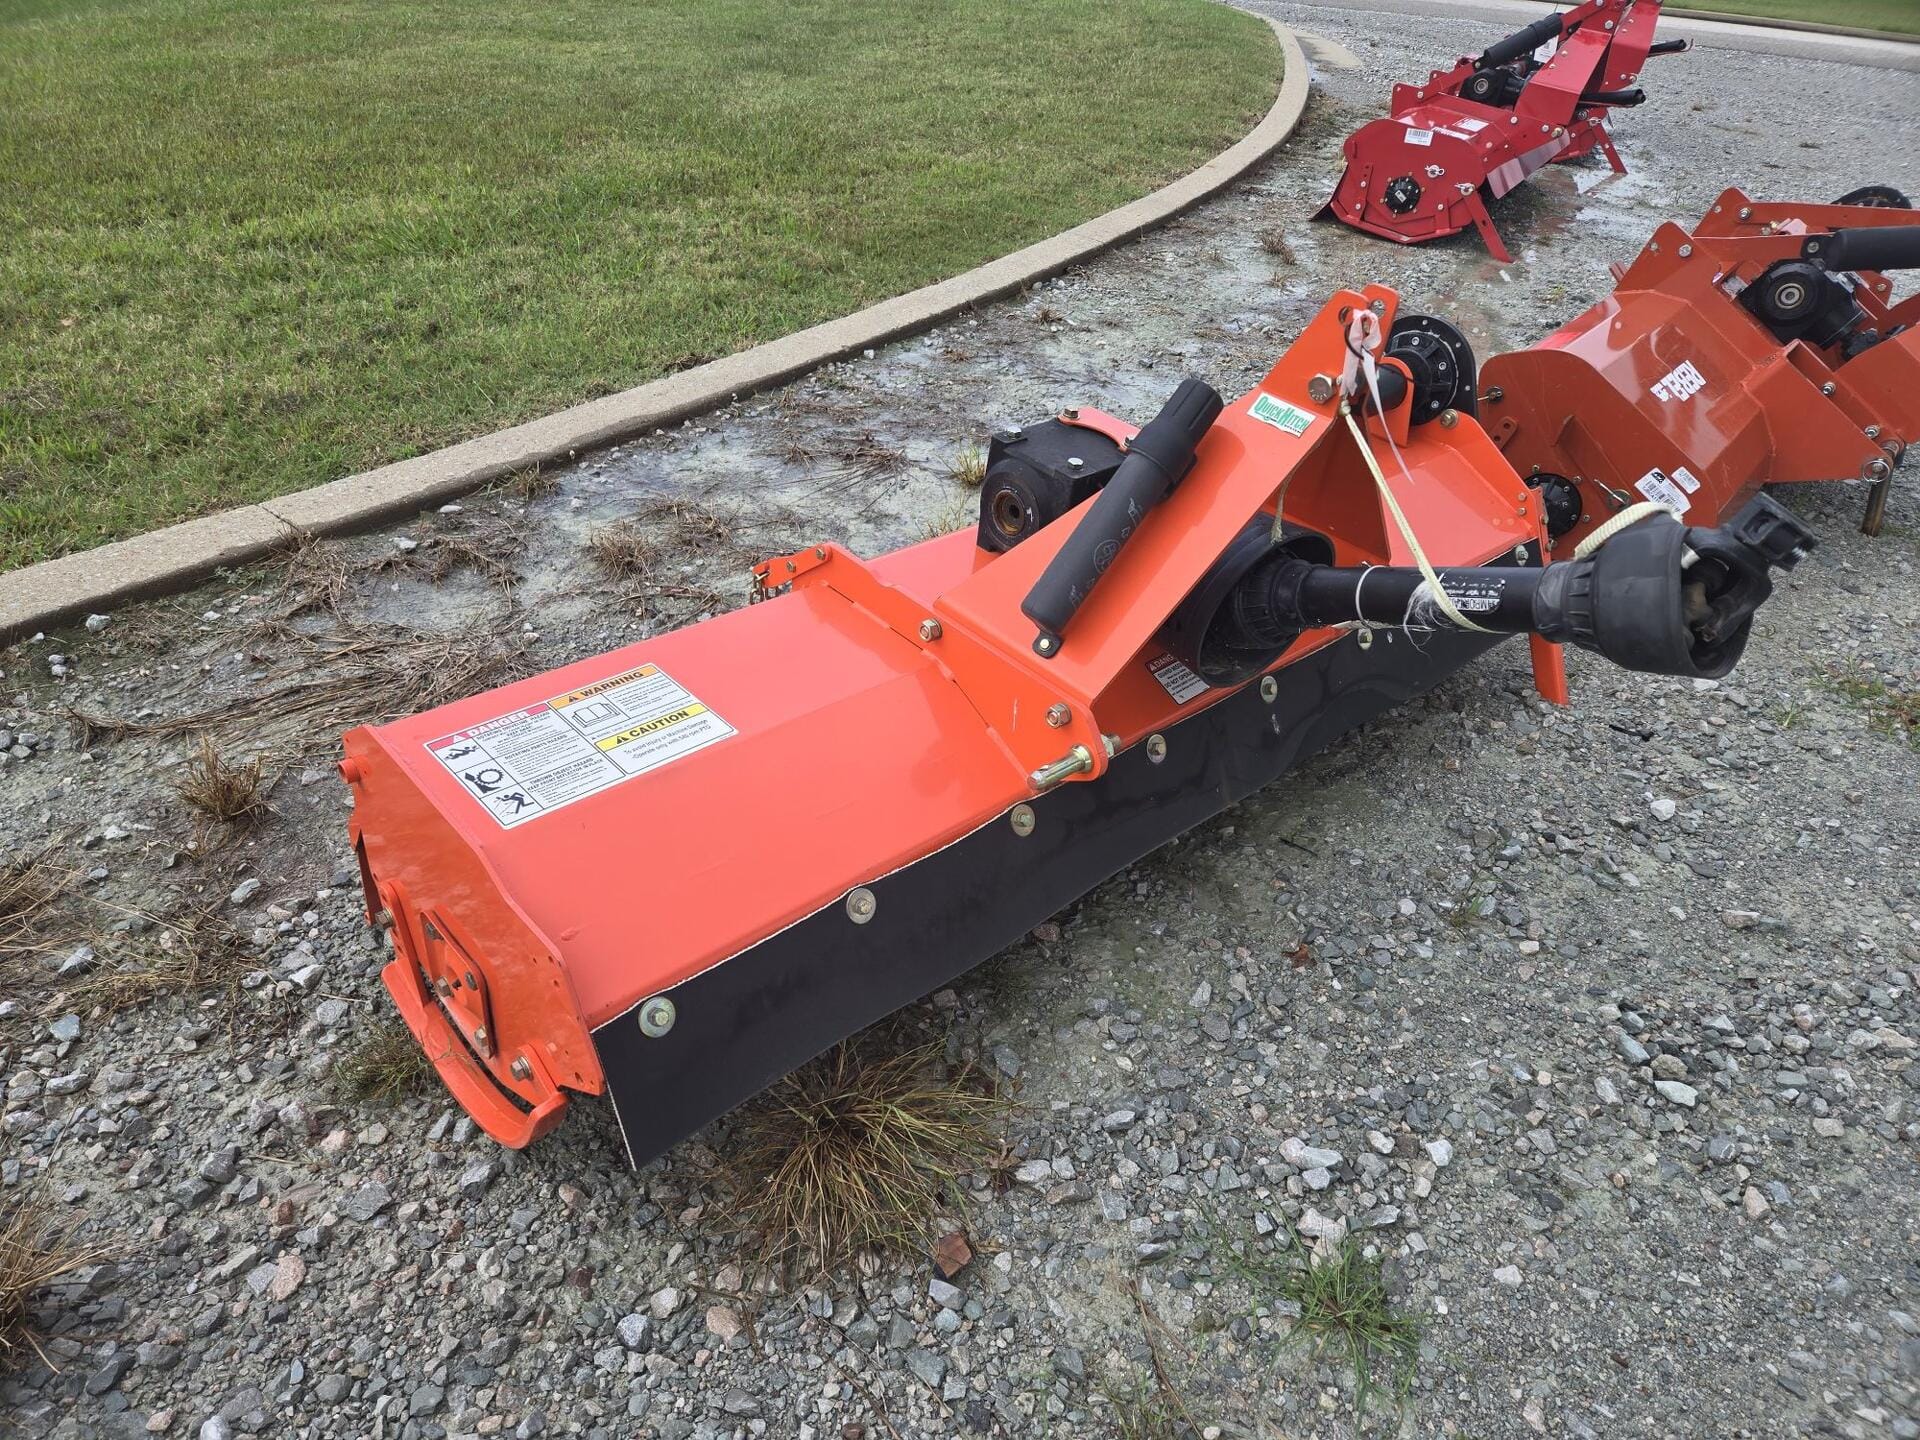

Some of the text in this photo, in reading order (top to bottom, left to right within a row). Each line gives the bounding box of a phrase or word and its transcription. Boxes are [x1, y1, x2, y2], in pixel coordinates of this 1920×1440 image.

[579, 671, 644, 697] WARNING
[466, 710, 530, 737] DANGER
[627, 710, 690, 737] CAUTION
